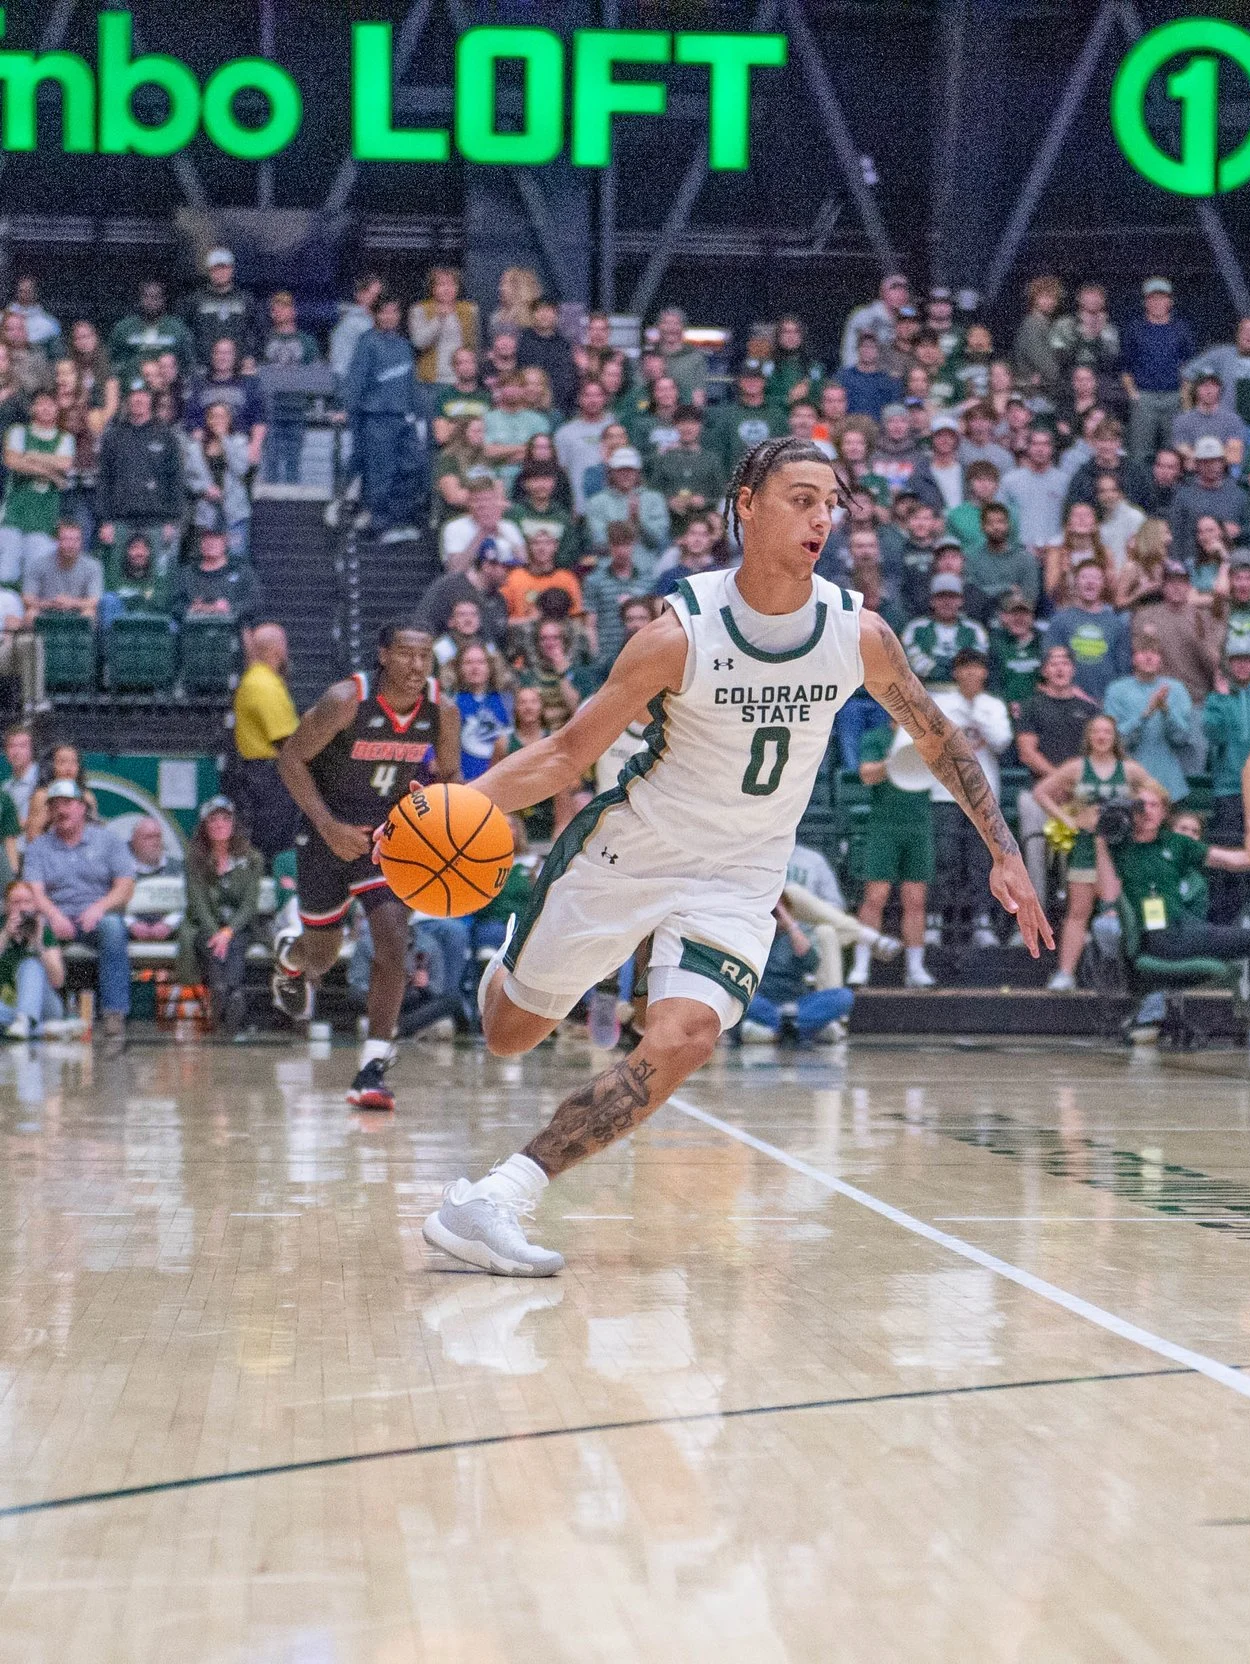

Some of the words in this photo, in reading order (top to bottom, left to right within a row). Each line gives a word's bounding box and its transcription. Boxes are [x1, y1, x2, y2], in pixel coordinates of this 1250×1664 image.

[352, 22, 788, 171] LOFT
[714, 685, 838, 704] COLORADO
[741, 704, 811, 723] STATE
[741, 726, 791, 796] 0
[371, 764, 399, 797] 4
